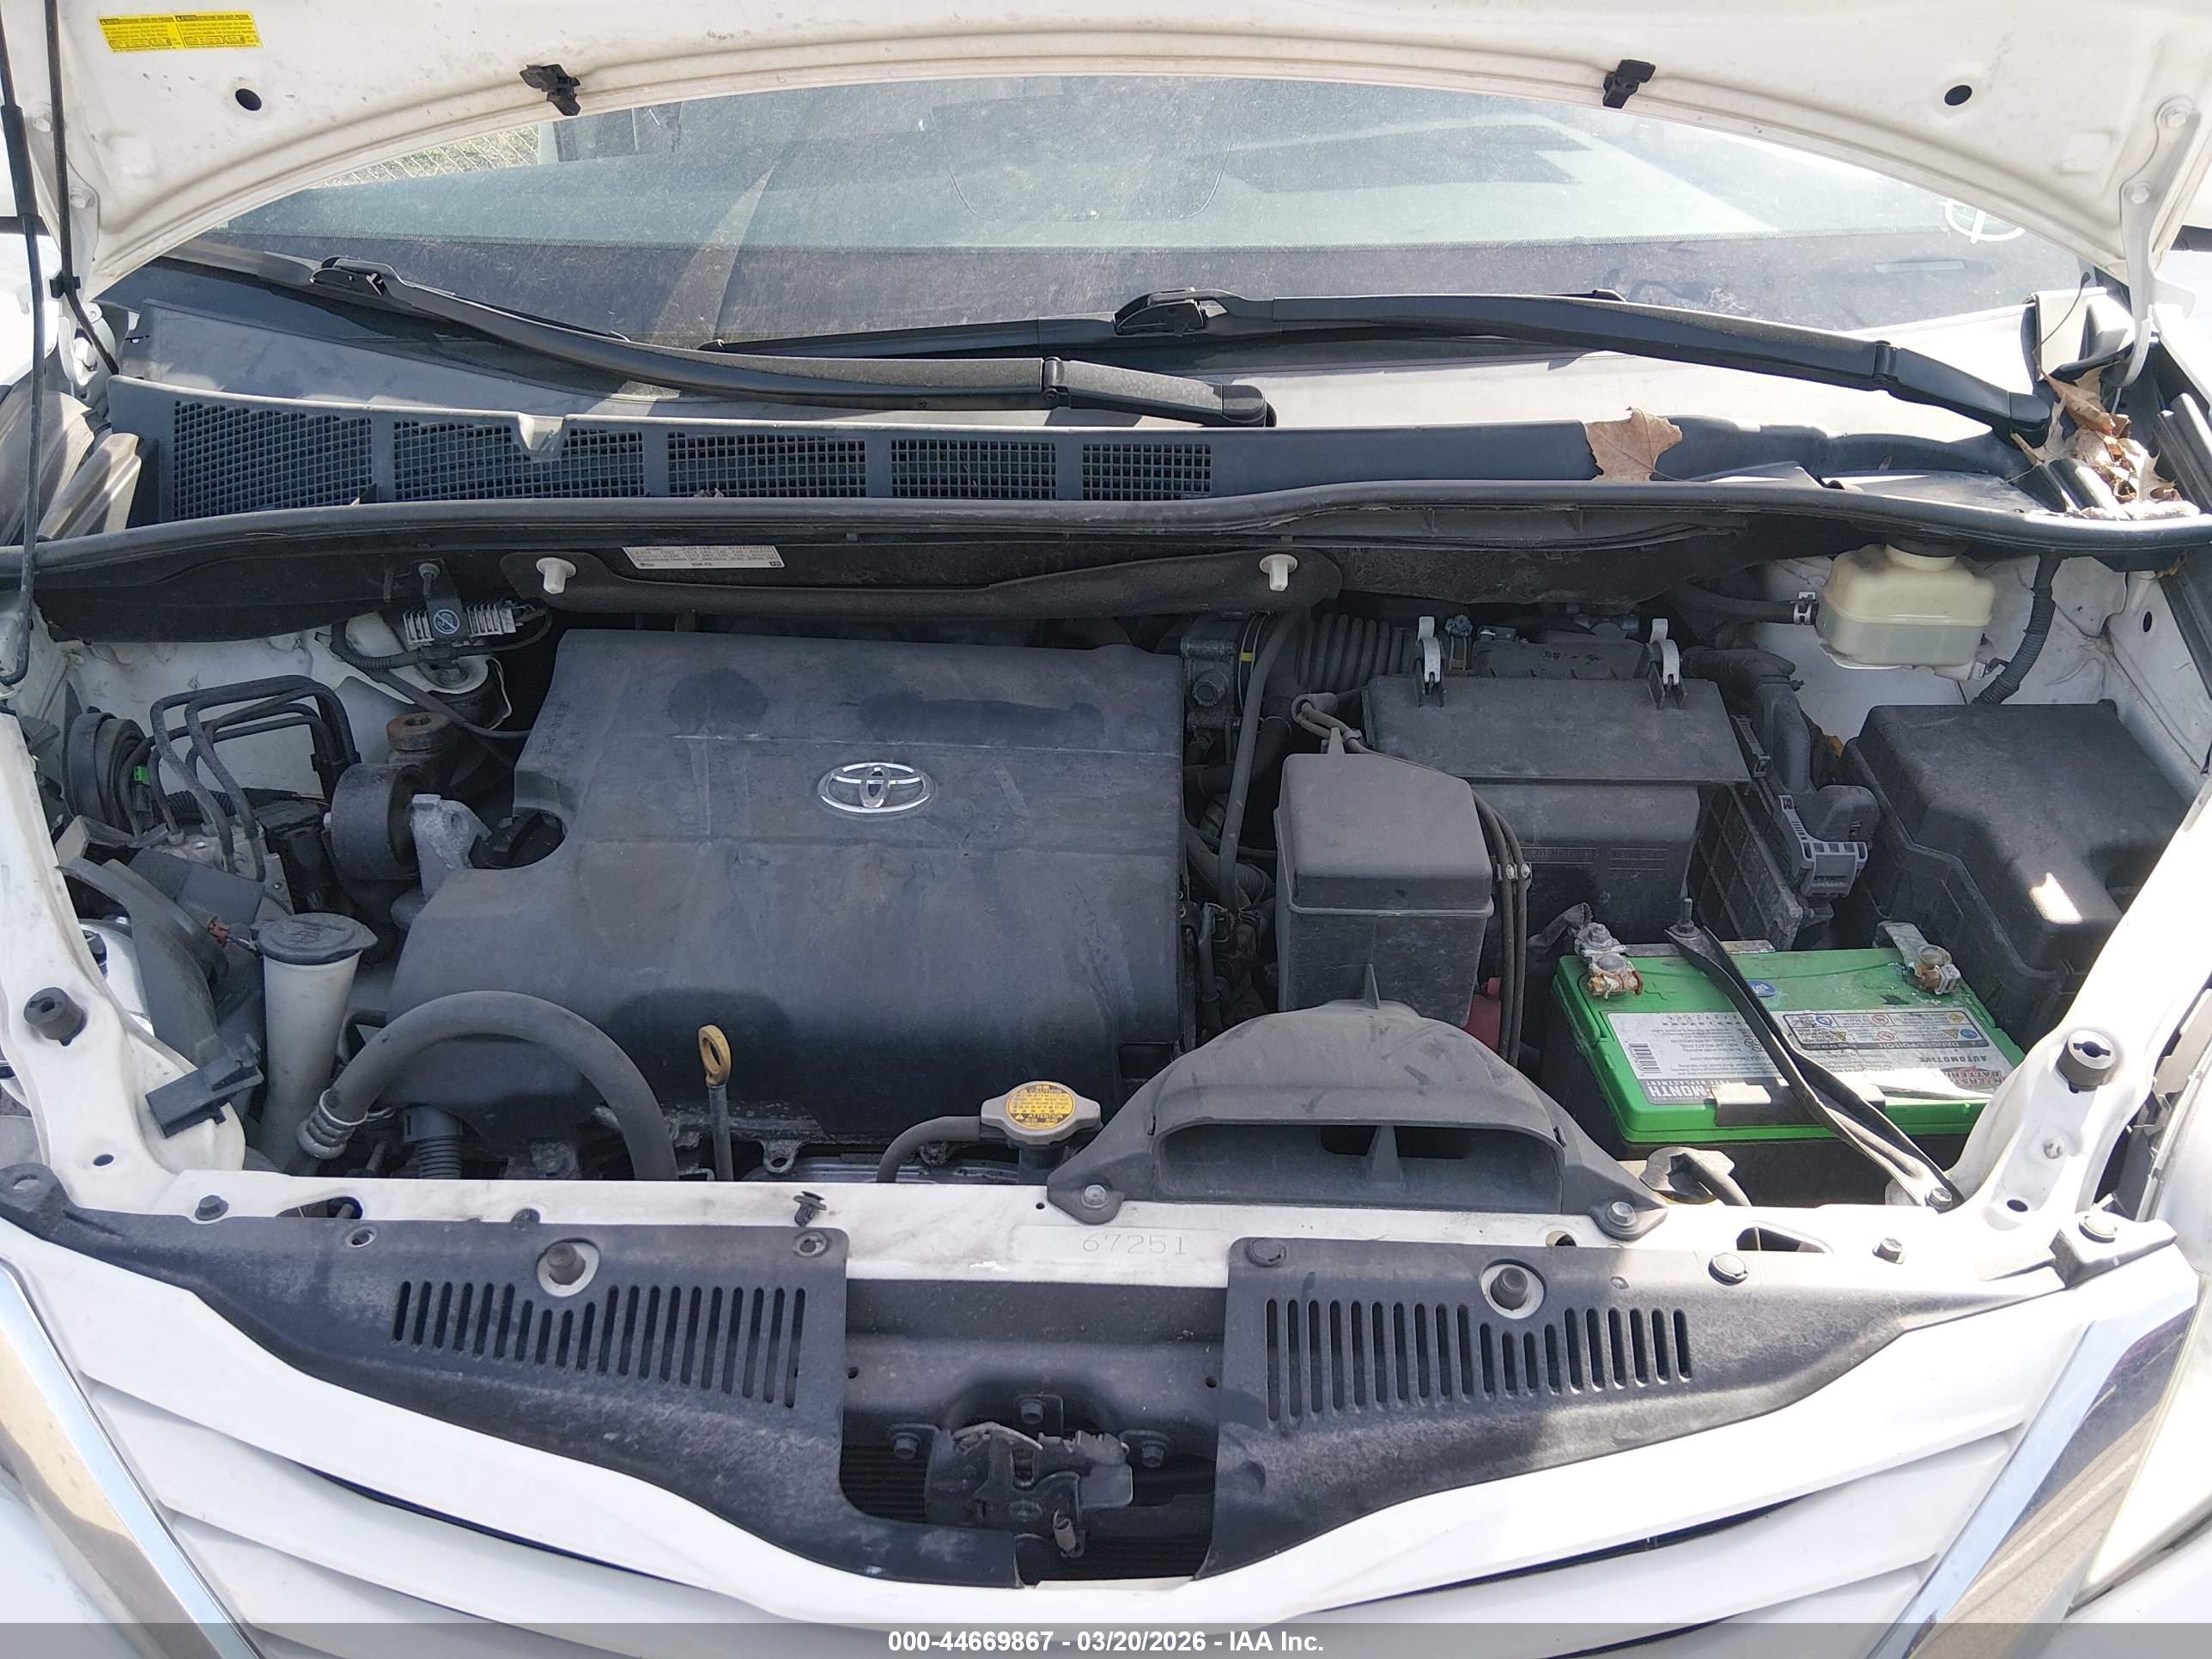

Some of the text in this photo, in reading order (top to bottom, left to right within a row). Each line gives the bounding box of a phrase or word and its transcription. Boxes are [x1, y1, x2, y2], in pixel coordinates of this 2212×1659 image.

[1918, 1054, 1987, 1063] AUTOMOTIVE
[1943, 1070, 2001, 1079] BATTERI
[1081, 1233, 1187, 1256] 67251
